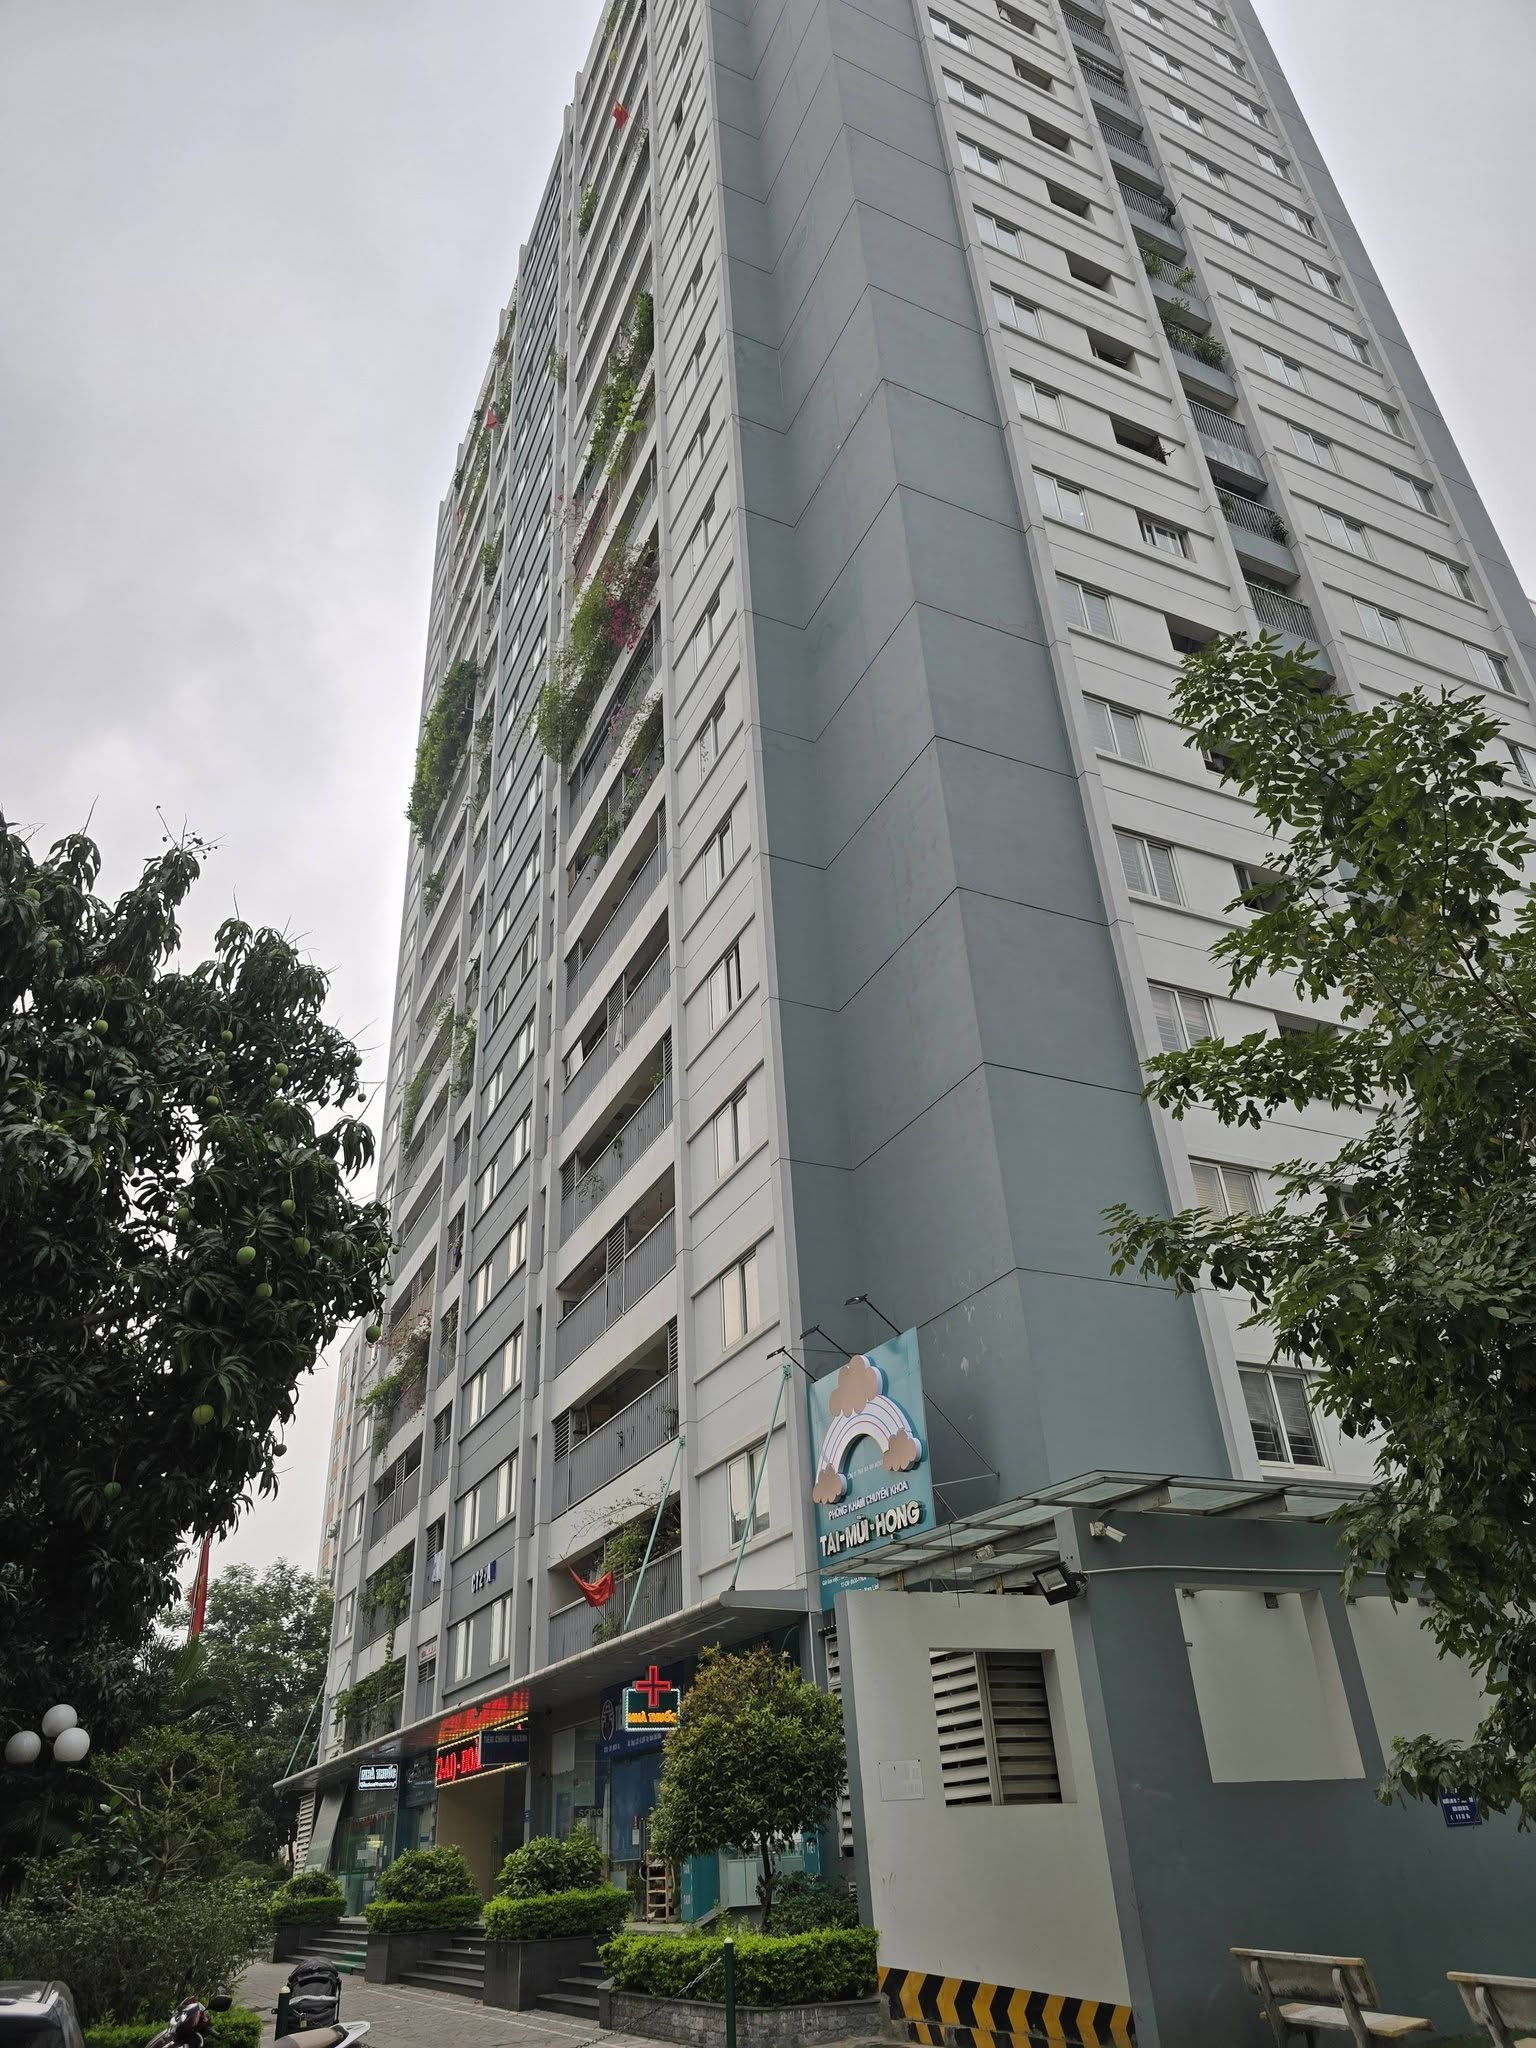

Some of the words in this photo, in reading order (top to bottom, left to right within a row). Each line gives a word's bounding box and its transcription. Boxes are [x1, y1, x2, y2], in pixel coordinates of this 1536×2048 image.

[828, 1503, 848, 1520] PHÒNG
[848, 1496, 866, 1513] KHÁM
[866, 1486, 889, 1505] CHUYÊN
[889, 1481, 909, 1496] KHOA
[626, 1710, 648, 1723] NHÀ
[648, 1709, 677, 1723] THUỐC
[361, 1767, 375, 1780] NHÀ
[376, 1765, 397, 1780] THUỐC
